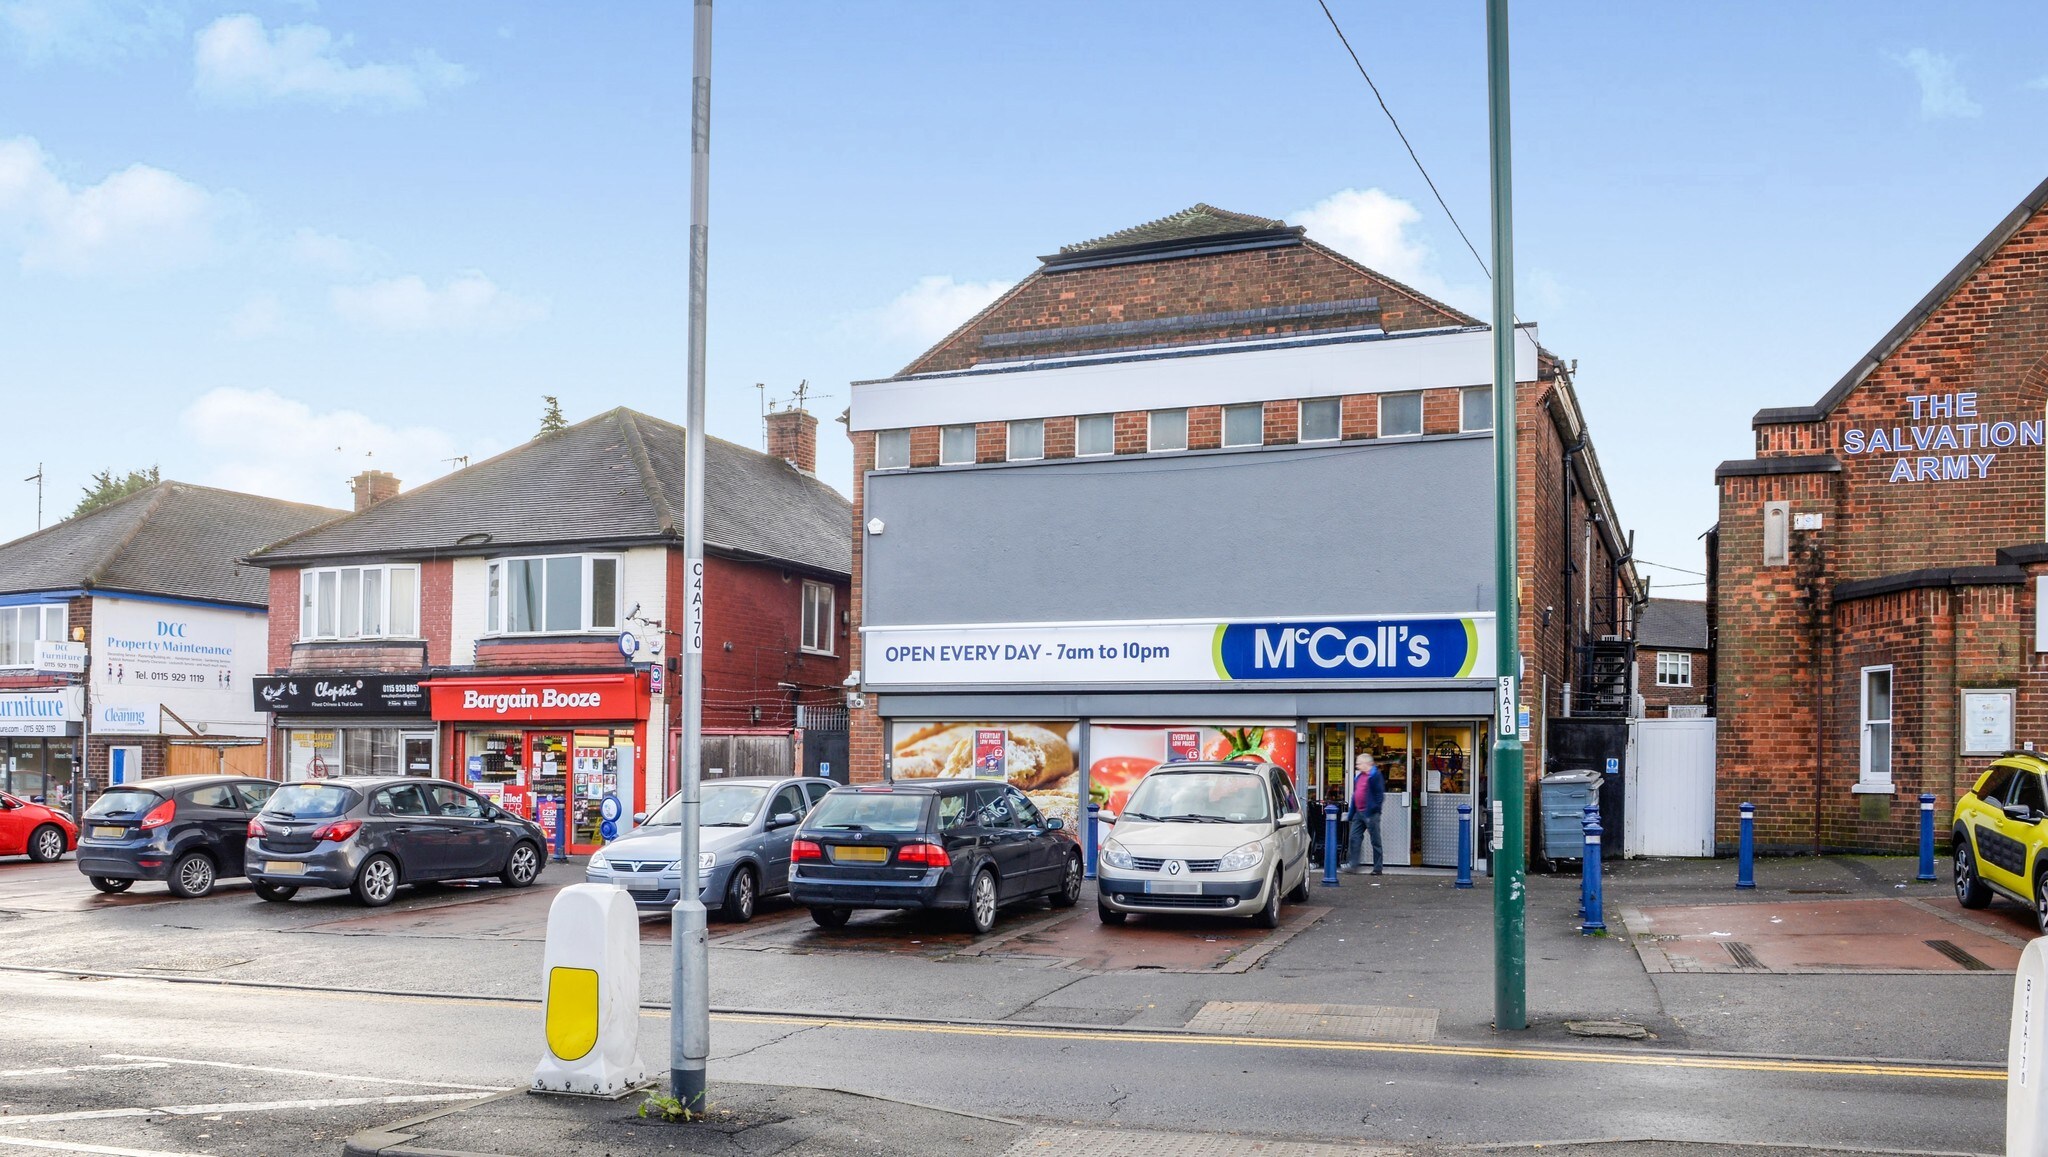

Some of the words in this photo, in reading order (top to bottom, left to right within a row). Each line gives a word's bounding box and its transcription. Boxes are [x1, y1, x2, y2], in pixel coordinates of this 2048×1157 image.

[1906, 392, 1978, 420] THE
[1843, 420, 2043, 454] SALVATION
[1889, 453, 1996, 483] ARMY
[157, 620, 188, 638] DCC
[55, 643, 69, 651] DCC
[107, 636, 160, 653] Property
[162, 640, 233, 656] Maintenance
[885, 646, 936, 662] OPEN
[940, 645, 1001, 661] EVERY
[1005, 644, 1042, 660] DAY
[1057, 643, 1094, 660] 7am
[1099, 643, 1118, 659] to
[1123, 642, 1170, 662] 10pm
[1254, 625, 1431, 669] McColl's
[42, 651, 82, 661] Furniture
[136, 671, 148, 680] Tel.
[151, 671, 169, 681] 0115
[172, 673, 186, 682] 929
[190, 674, 205, 683] 1119
[315, 681, 358, 701] Chopstix
[382, 685, 395, 693] 0115
[395, 685, 406, 693] 929
[463, 687, 539, 713] Bargain
[541, 688, 601, 708] Booze
[104, 707, 145, 725] Cleaning
[23, 724, 34, 733] 0115
[35, 724, 45, 733] 929
[46, 724, 56, 733] 1119
[1172, 733, 1196, 741] EVERYDAY
[994, 749, 1003, 757] £2
[1188, 751, 1198, 759] £5
